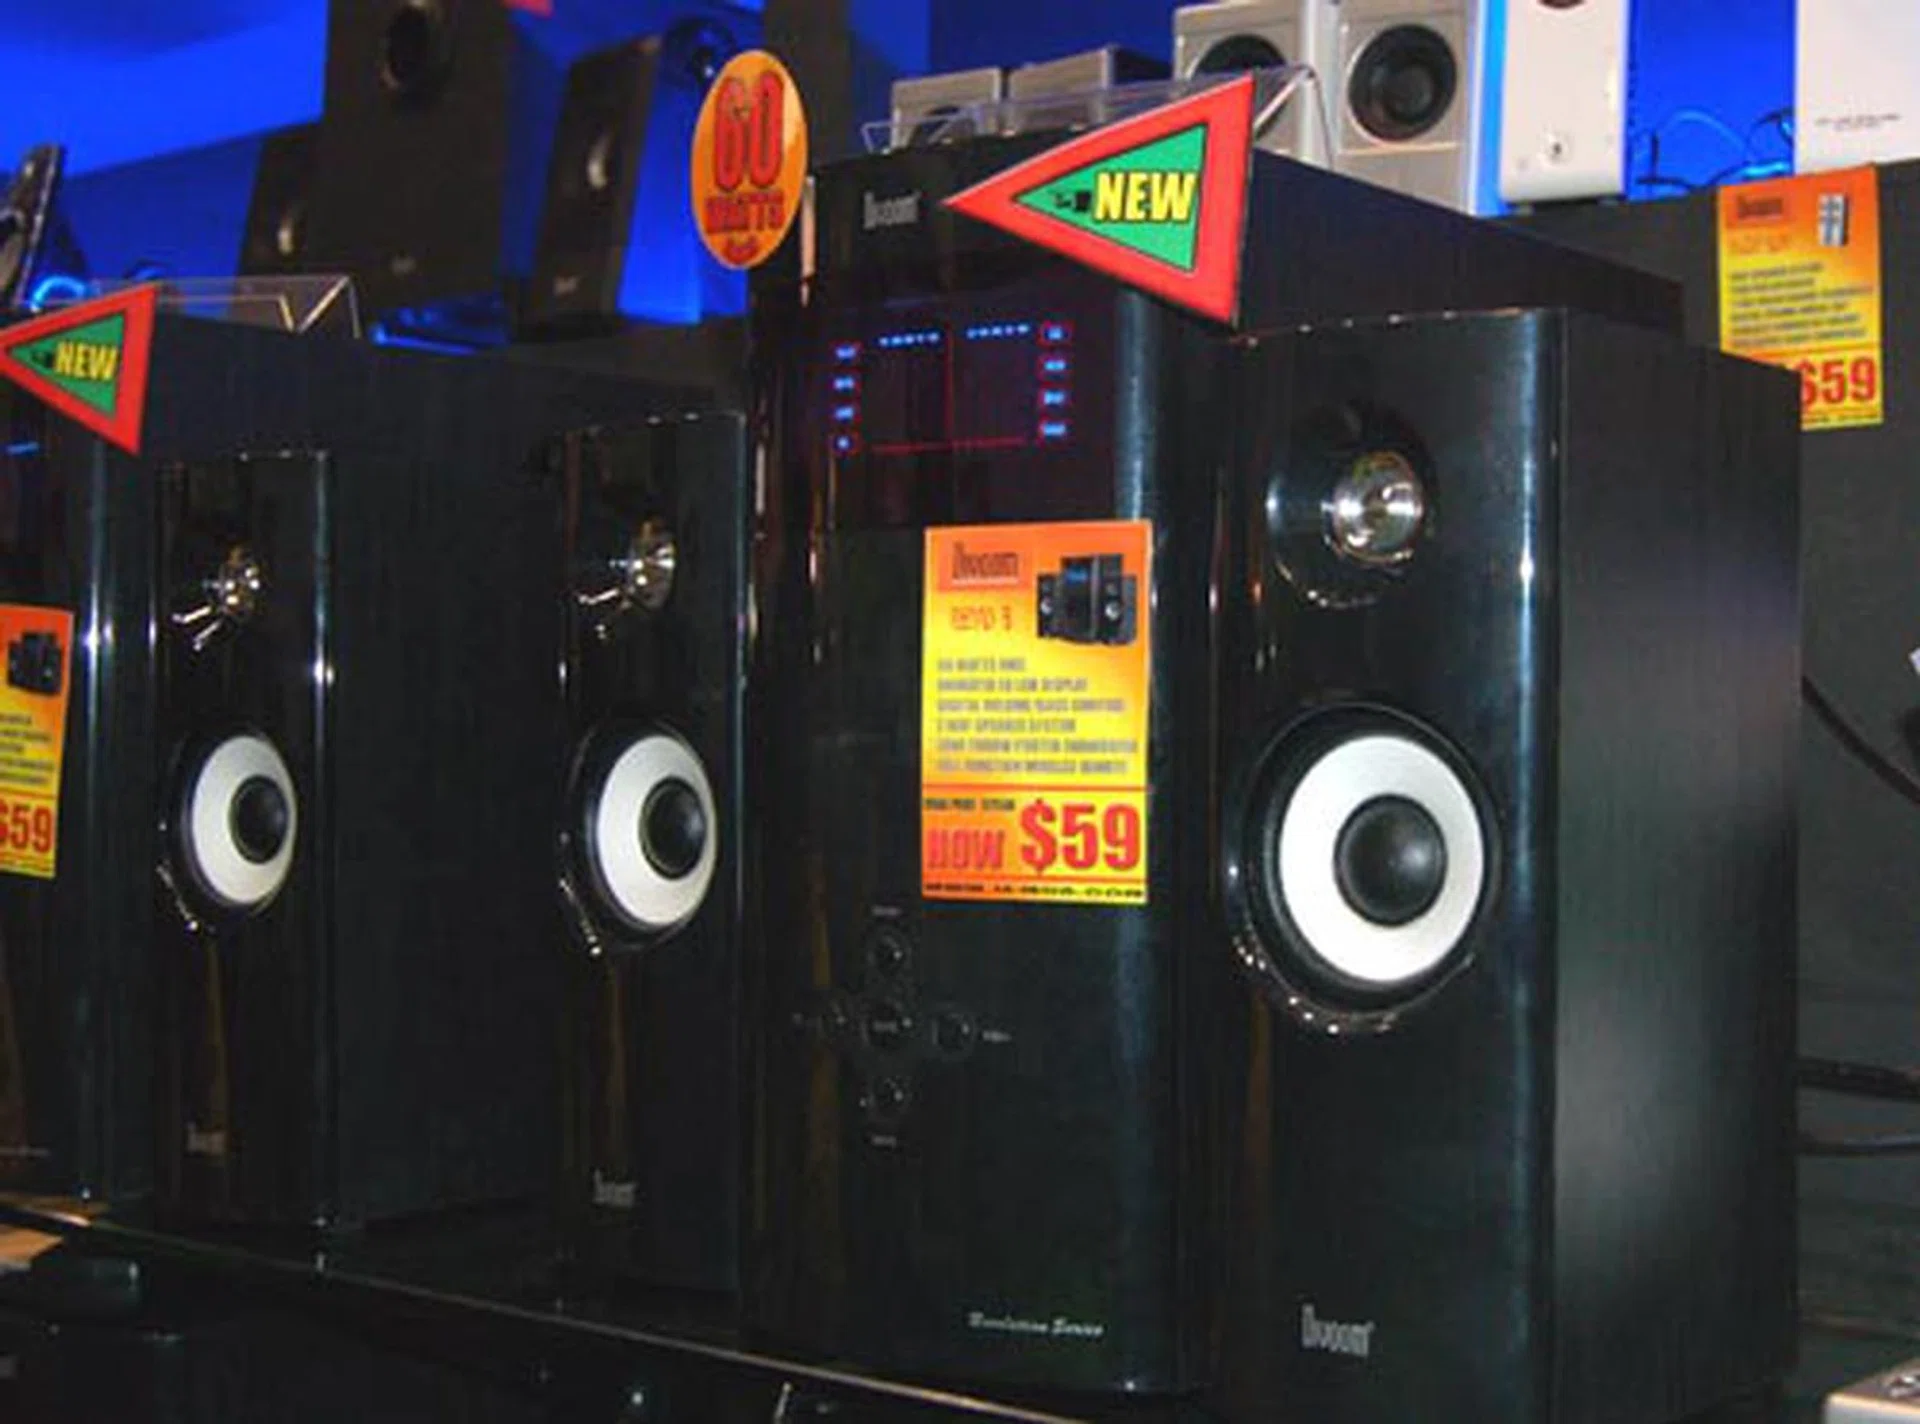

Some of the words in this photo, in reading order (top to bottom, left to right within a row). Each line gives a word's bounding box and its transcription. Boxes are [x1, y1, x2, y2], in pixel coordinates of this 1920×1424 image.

[713, 70, 784, 193] 60
[1093, 171, 1197, 222] NEW
[54, 339, 119, 381] NEW
[926, 829, 1005, 870] NOW
[1018, 797, 1142, 877] $59
